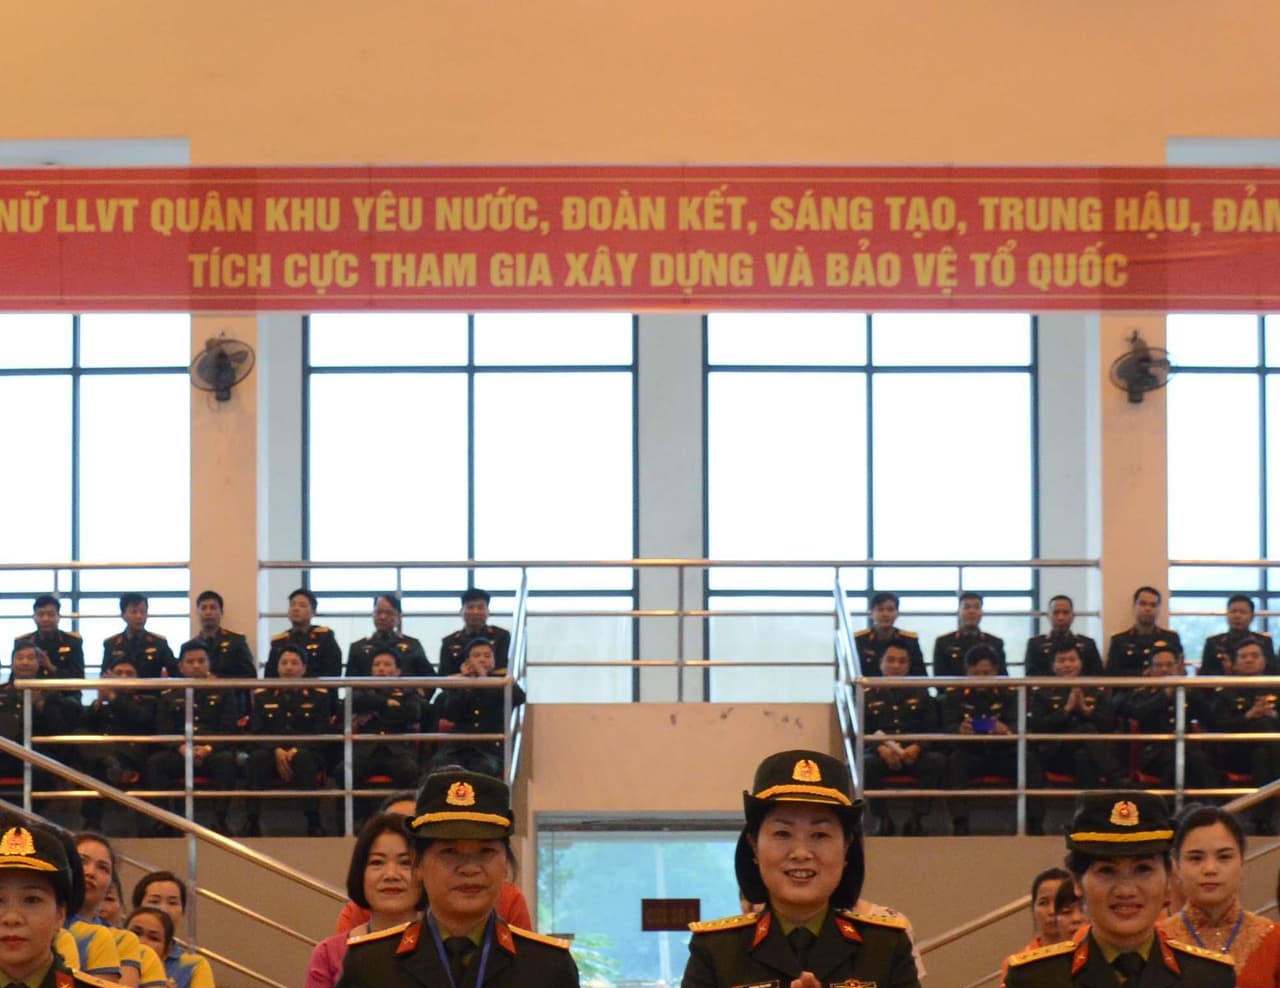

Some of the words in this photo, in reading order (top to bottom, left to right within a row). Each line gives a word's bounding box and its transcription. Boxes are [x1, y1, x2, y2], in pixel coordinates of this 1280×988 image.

[56, 198, 139, 232] LLVT
[150, 191, 253, 236] QUÂN
[265, 197, 340, 231] KHU
[353, 190, 423, 231] YÊU
[435, 187, 550, 235] NƯỚC,
[561, 189, 666, 231] ĐOÀN
[678, 185, 758, 235] KẾT,
[770, 190, 874, 231] SÁNG
[885, 197, 967, 238] TẠO,
[979, 197, 1103, 232] TRUNG
[1115, 191, 1201, 239] HẬU,
[188, 248, 272, 288] TÍCH
[284, 250, 360, 294] CỰC
[371, 253, 478, 288] THAM
[490, 253, 553, 287] GIA
[565, 246, 639, 287] XÂY
[650, 249, 754, 295] DỰNG
[765, 246, 814, 287] VÀ
[826, 238, 901, 287] BẢO
[913, 246, 958, 295] VỆ
[970, 239, 1017, 287] TỔ
[1027, 242, 1128, 291] QUỐC
